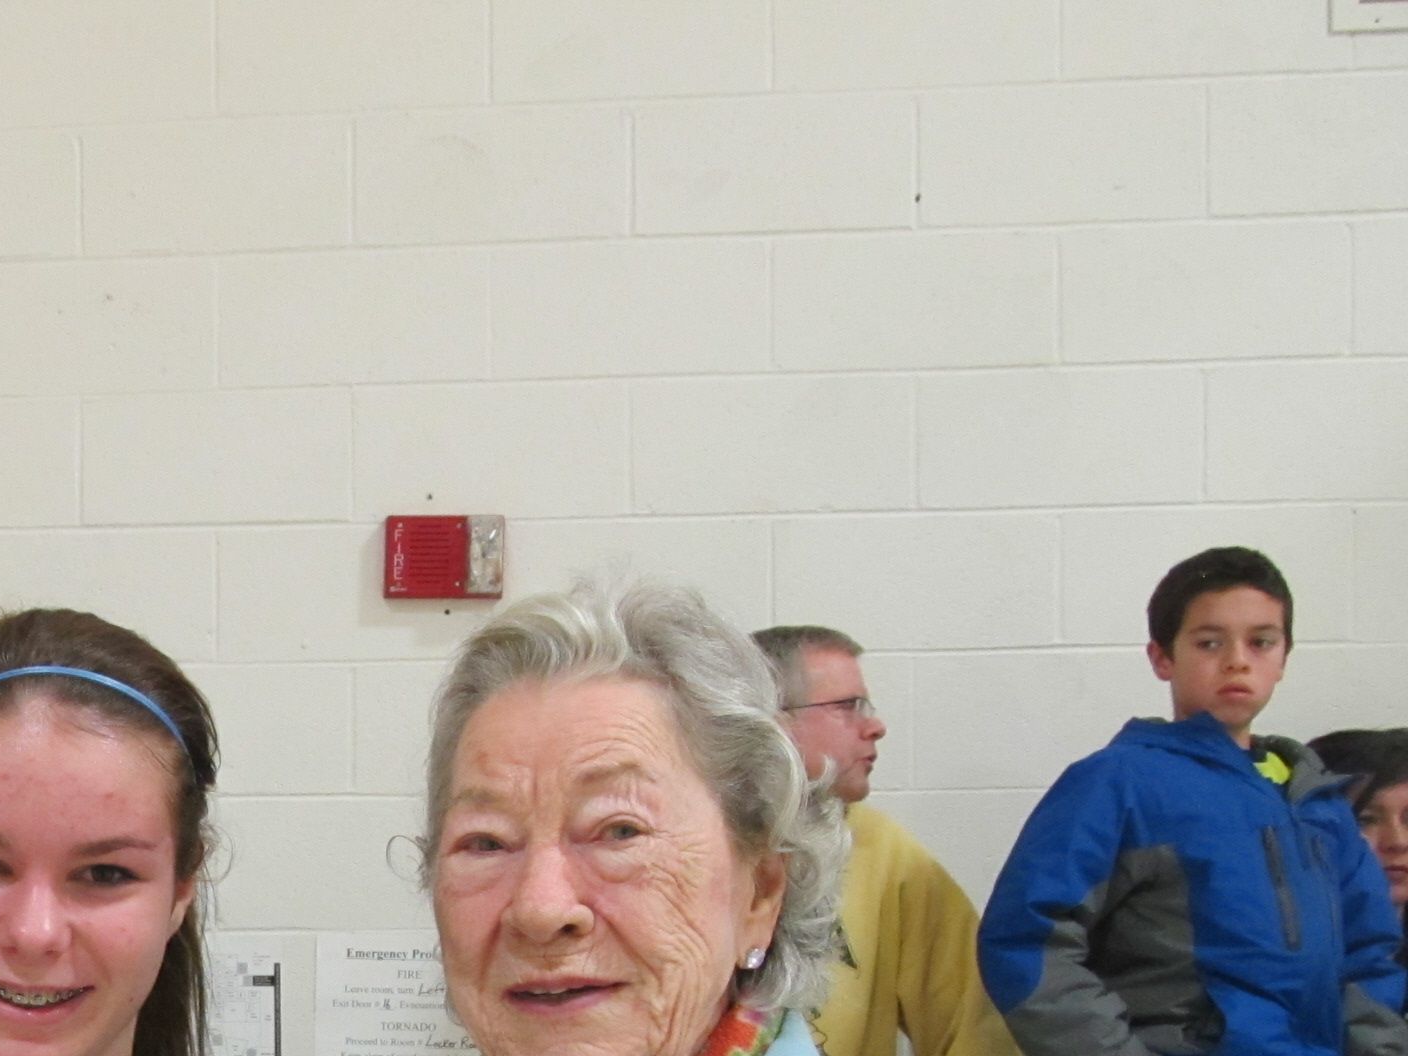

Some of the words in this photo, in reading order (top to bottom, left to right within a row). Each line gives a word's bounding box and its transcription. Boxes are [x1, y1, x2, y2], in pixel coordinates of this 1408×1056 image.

[393, 529, 404, 580] FIRE
[347, 948, 408, 961] Emergency
[412, 949, 434, 960] Pro
[397, 969, 424, 980] FIRE
[345, 985, 368, 995] Leave
[332, 999, 349, 1008] Exit
[351, 999, 372, 1009] Door
[381, 1021, 437, 1032] TORNADO
